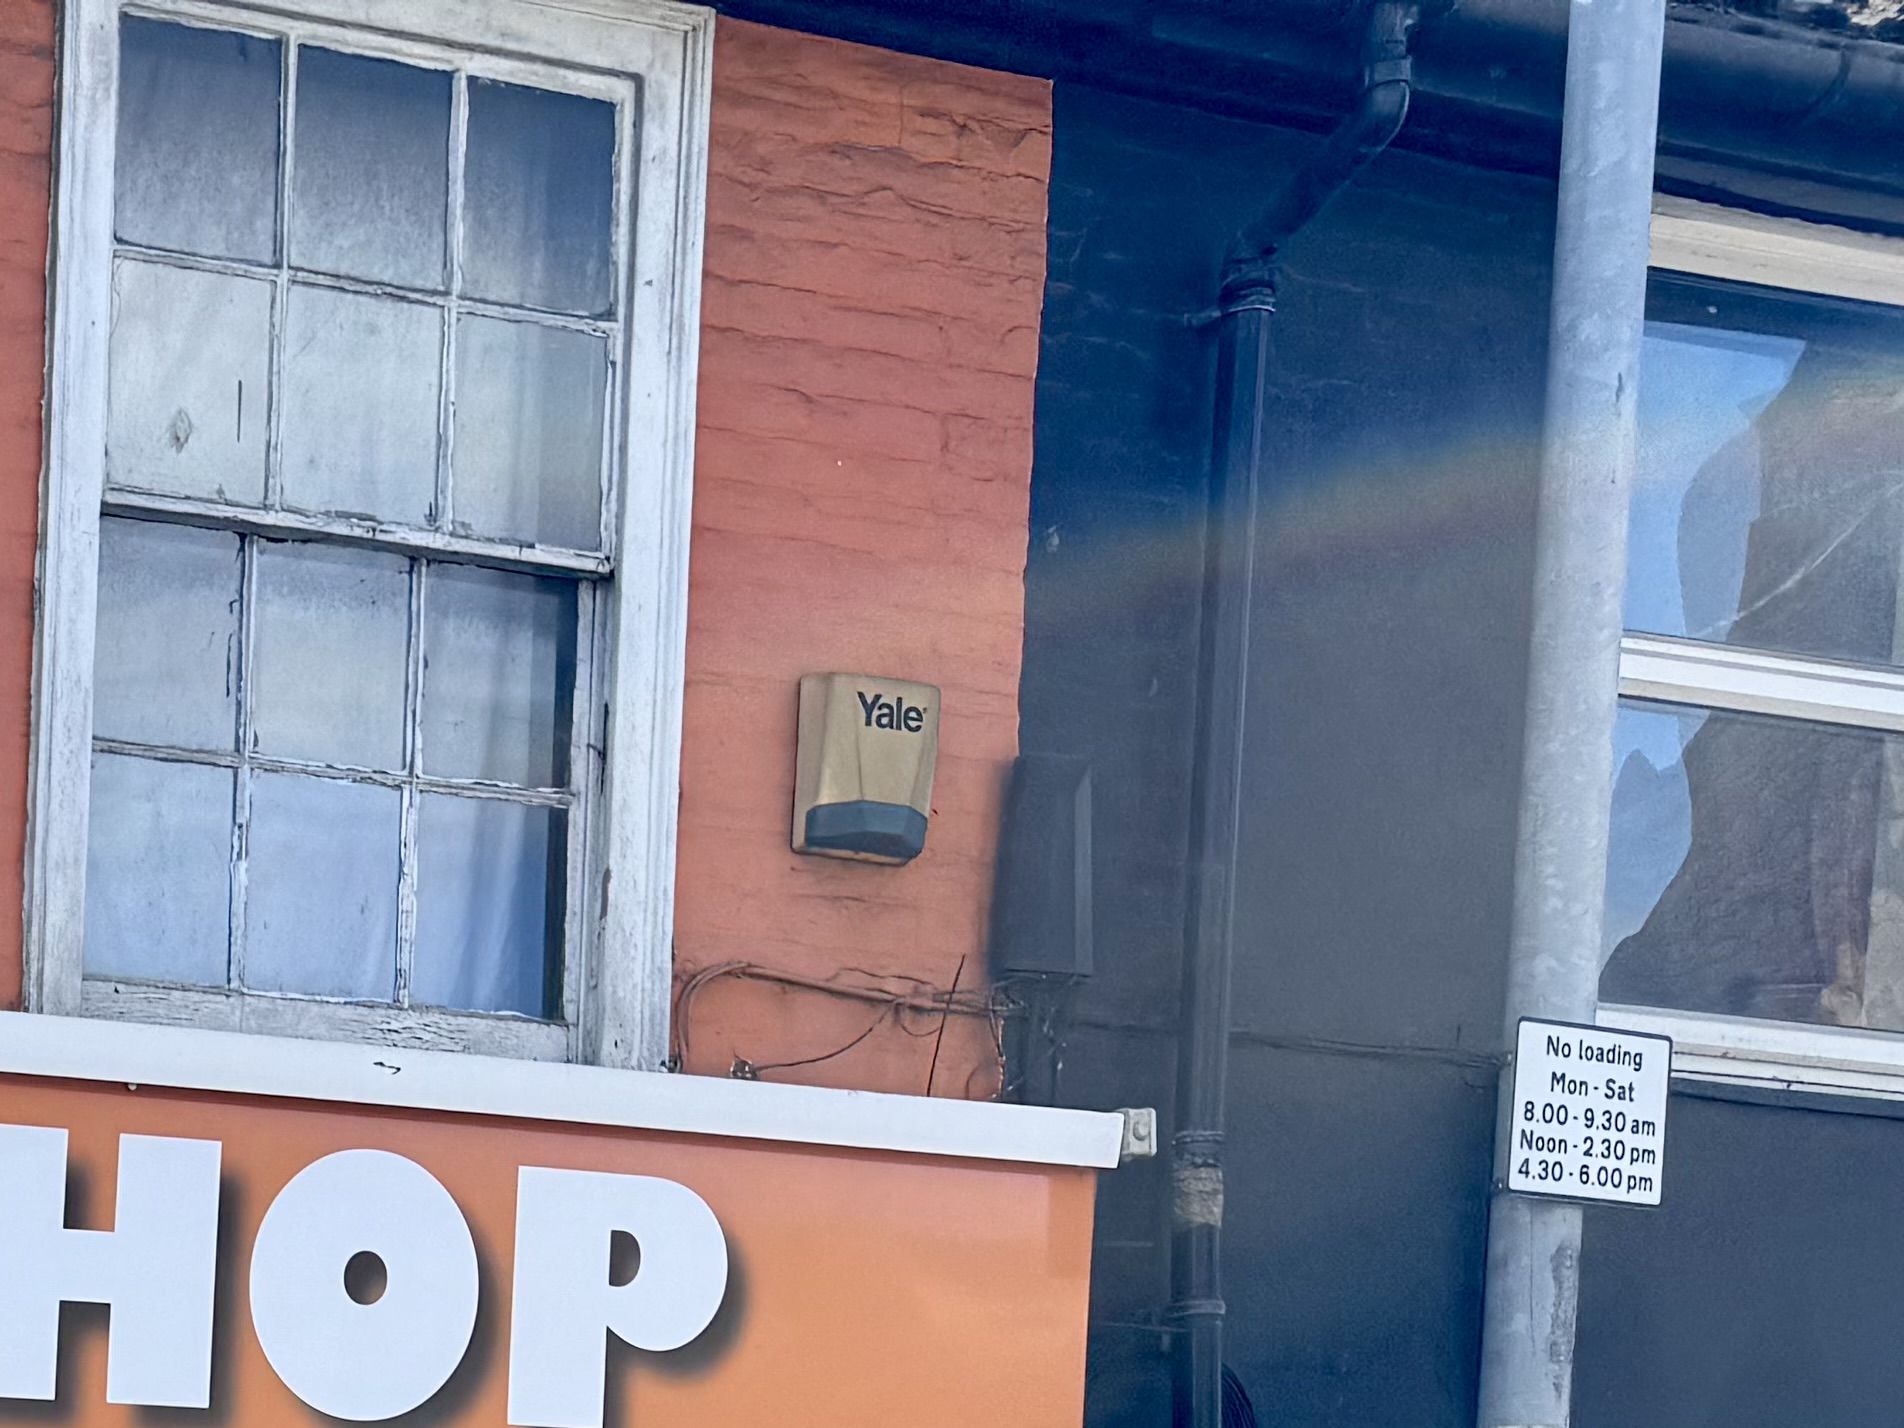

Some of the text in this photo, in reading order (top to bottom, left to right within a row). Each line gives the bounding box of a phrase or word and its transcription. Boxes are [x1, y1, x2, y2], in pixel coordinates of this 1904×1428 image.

[856, 690, 924, 733] Yale
[1546, 1034, 1643, 1072] No loading
[1550, 1071, 1589, 1097] Mon
[1604, 1078, 1635, 1102] Sat
[1523, 1101, 1568, 1126] 8.00
[1583, 1107, 1626, 1132] 9.30
[1630, 1118, 1656, 1137] am
[1520, 1128, 1568, 1155] Noon
[1582, 1136, 1626, 1161] 2.30
[1629, 1147, 1656, 1165] pm
[1517, 1157, 1564, 1181] 4.30
[1579, 1164, 1623, 1189] 6.00
[1626, 1174, 1653, 1194] pm
